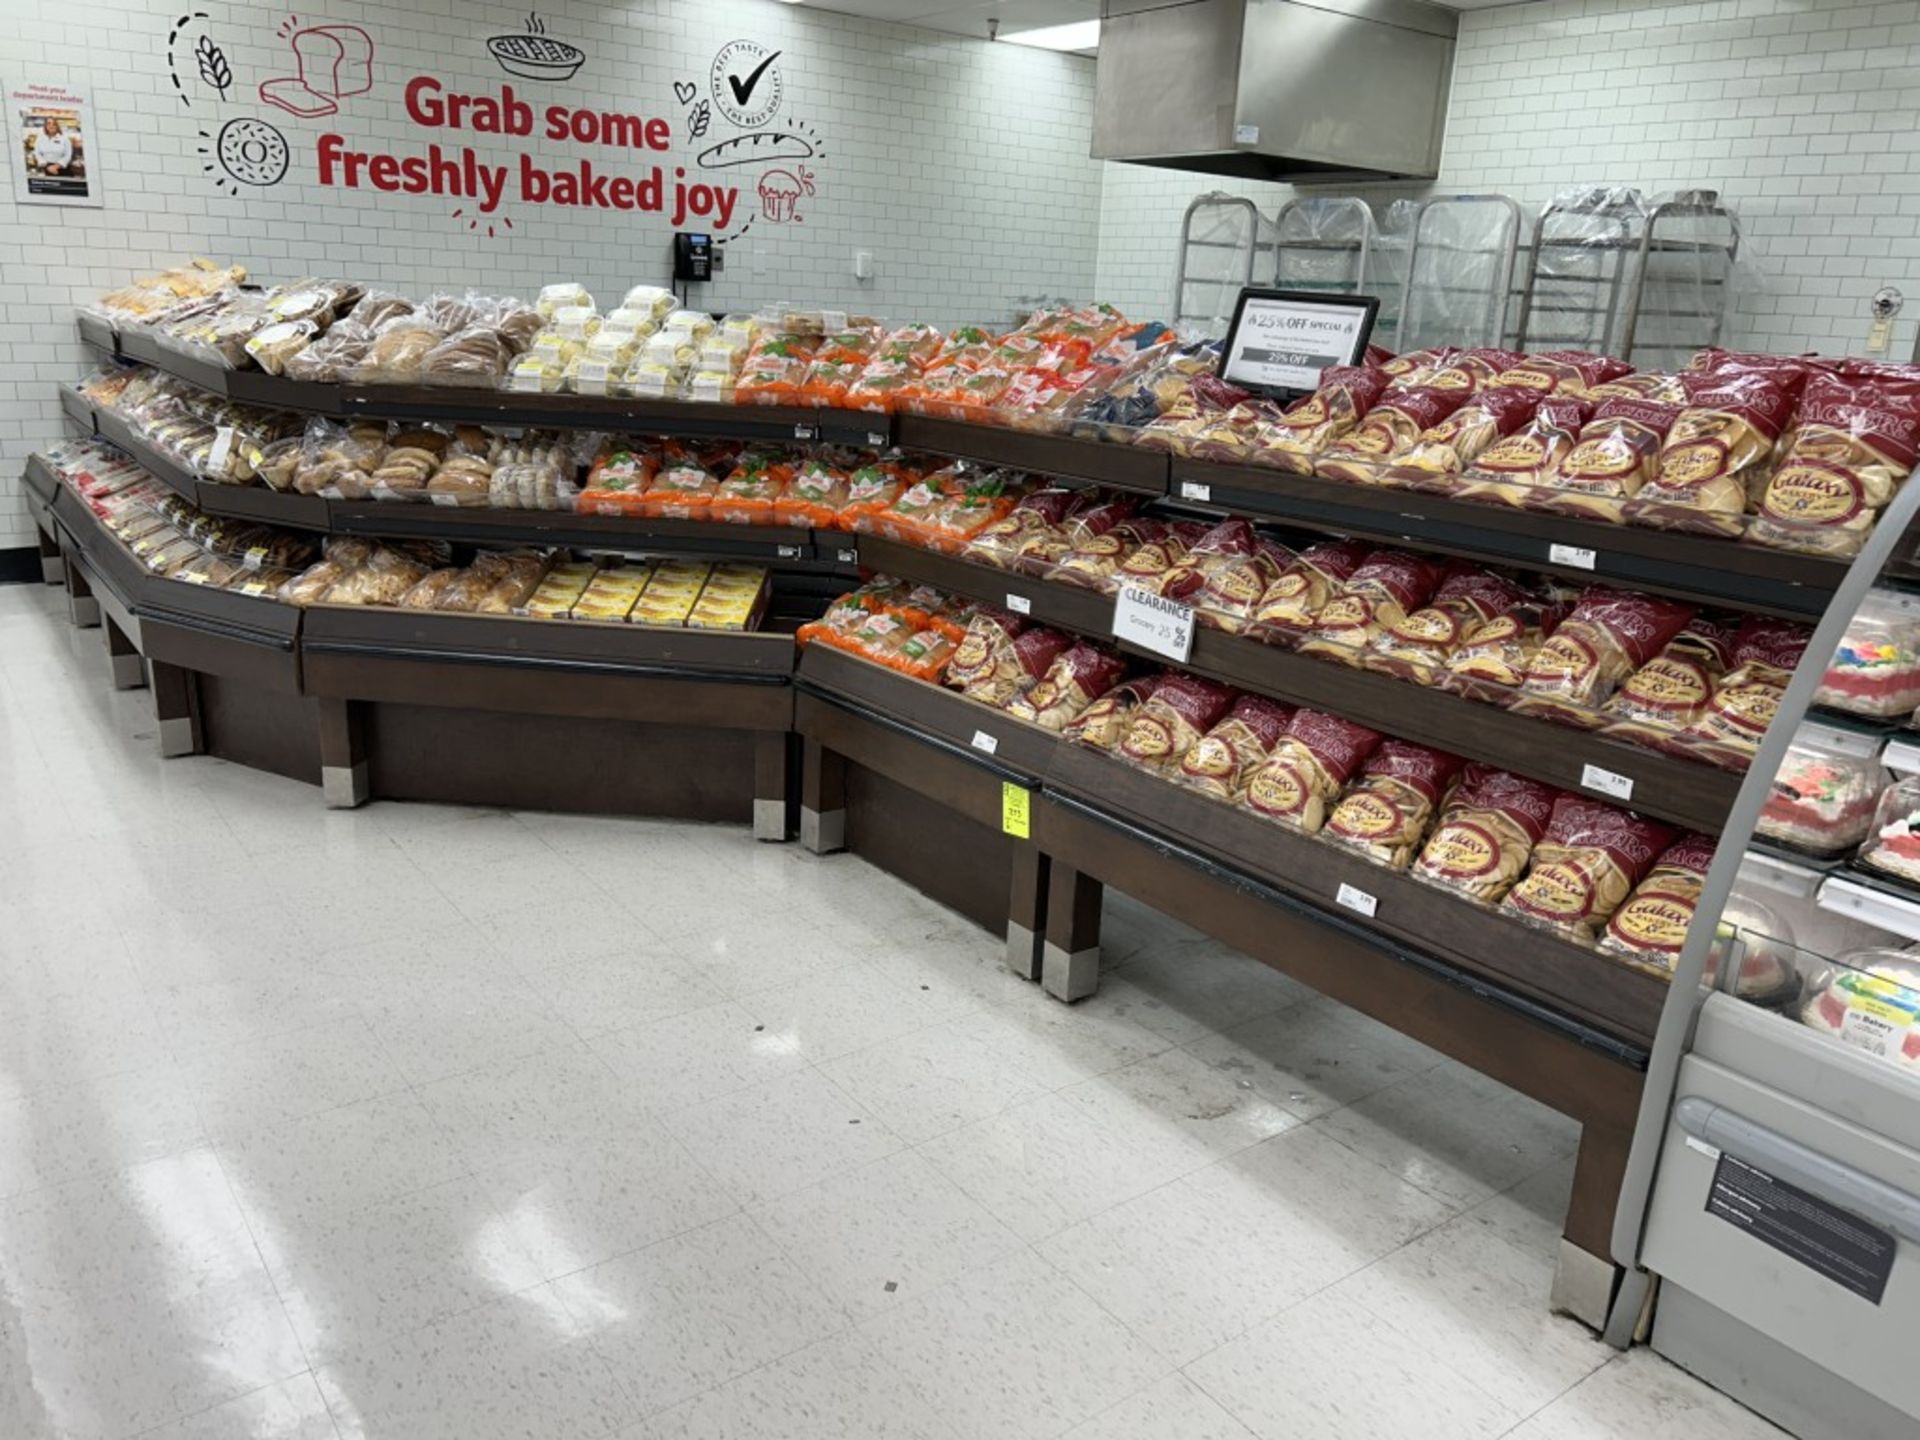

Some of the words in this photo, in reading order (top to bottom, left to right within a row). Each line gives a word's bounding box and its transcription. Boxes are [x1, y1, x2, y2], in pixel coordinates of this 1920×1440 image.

[716, 48, 732, 72] BEST
[734, 43, 763, 58] TASTE
[714, 76, 722, 97] THE
[405, 76, 533, 136] Grab
[547, 106, 671, 152] some
[317, 134, 508, 213] freshly
[520, 154, 663, 211] baked
[671, 167, 738, 230] joy
[1257, 313, 1286, 329] 25%
[1286, 318, 1309, 330] OFF
[1309, 322, 1342, 331] SPECIAL
[1289, 355, 1309, 364] OFF
[1773, 474, 1850, 498] Galaxy
[1125, 587, 1190, 621] CLEARANCE
[1130, 614, 1155, 632] Grocery
[1862, 1015, 1893, 1033] Bakery
